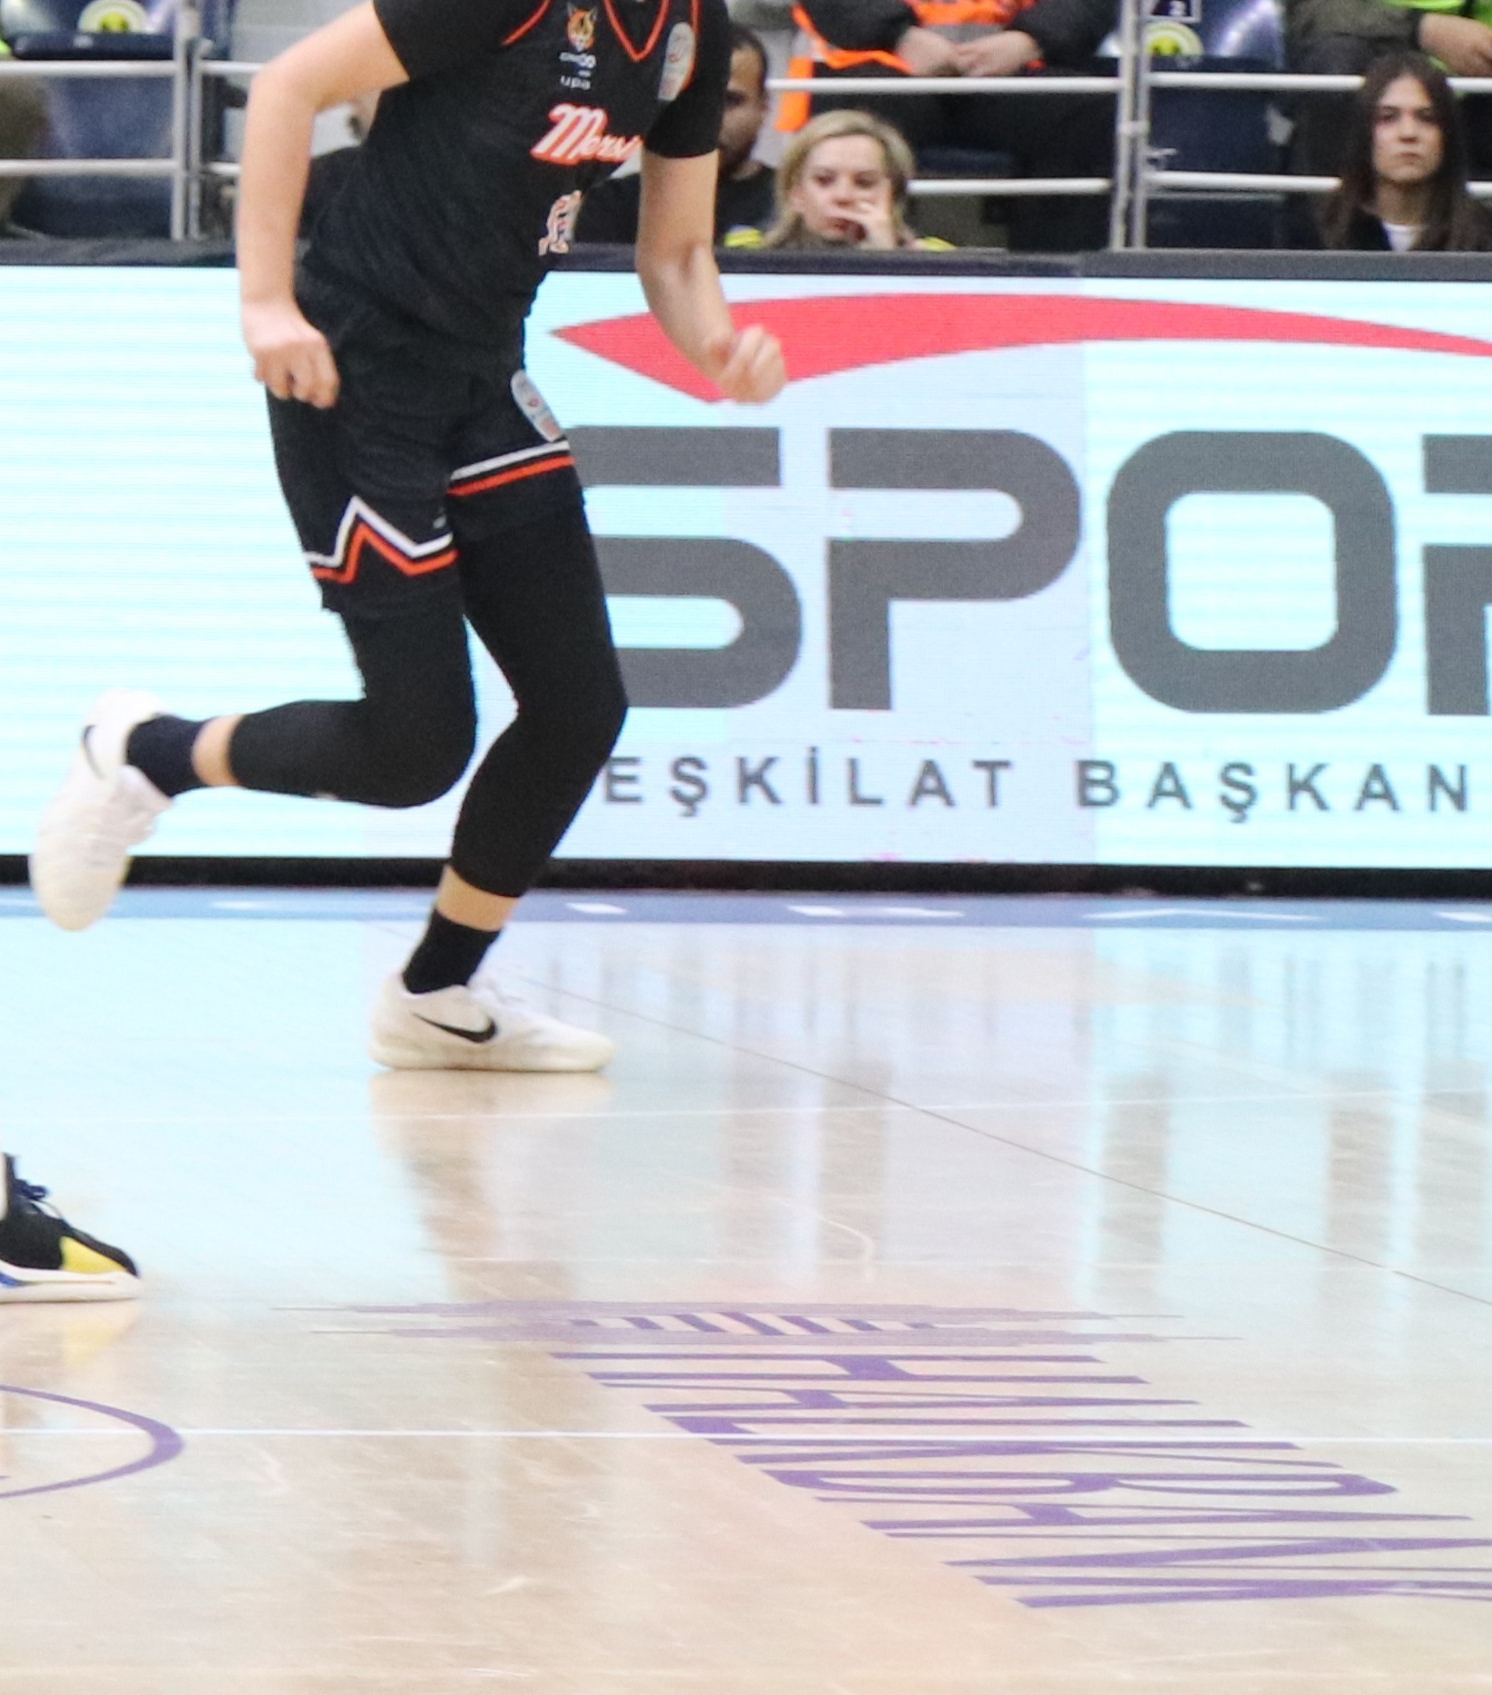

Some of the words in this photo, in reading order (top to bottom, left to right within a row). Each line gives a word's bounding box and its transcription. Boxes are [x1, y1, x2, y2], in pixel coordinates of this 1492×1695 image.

[565, 425, 1492, 716] SPO
[604, 745, 1013, 818] EŞKİLAT
[1077, 760, 1469, 823] BAŞKAN
